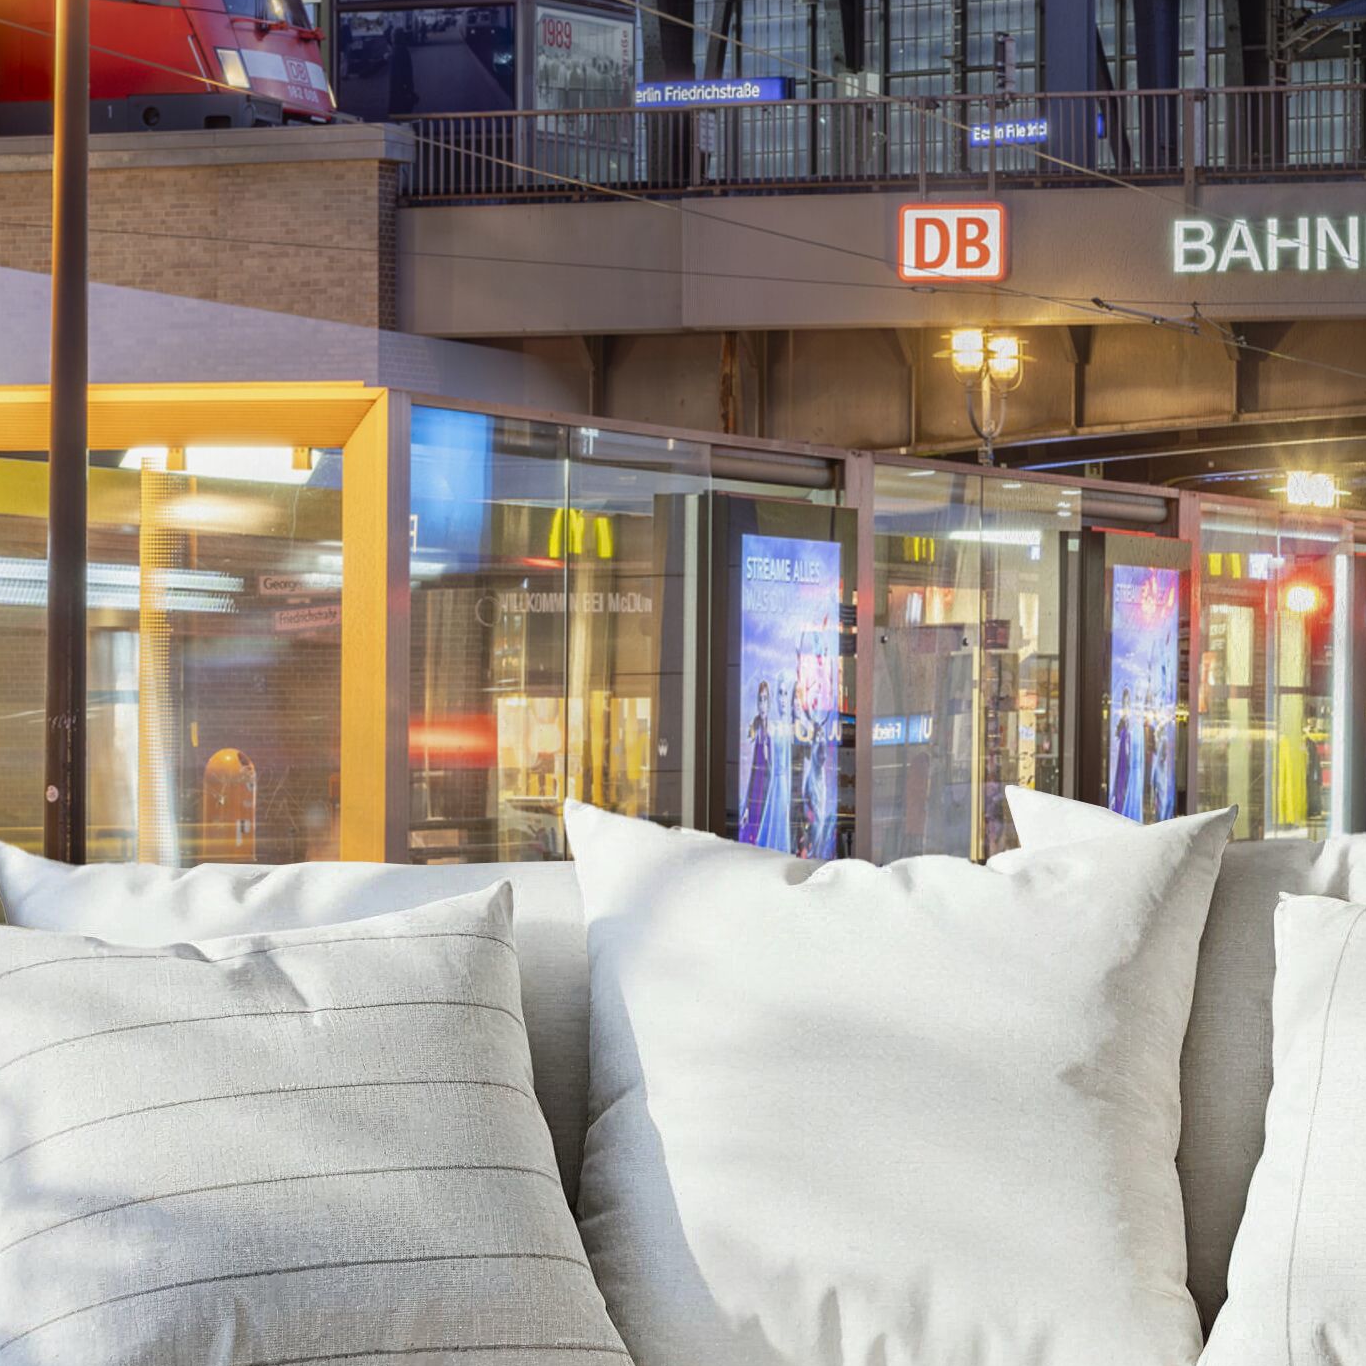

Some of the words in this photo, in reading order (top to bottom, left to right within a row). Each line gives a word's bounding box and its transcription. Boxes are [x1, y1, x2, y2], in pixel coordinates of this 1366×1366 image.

[541, 18, 572, 49] 1989
[664, 82, 761, 102] Friedrichstraße
[915, 217, 991, 270] DB
[747, 556, 791, 582] STREAME
[794, 559, 820, 584] ALLES
